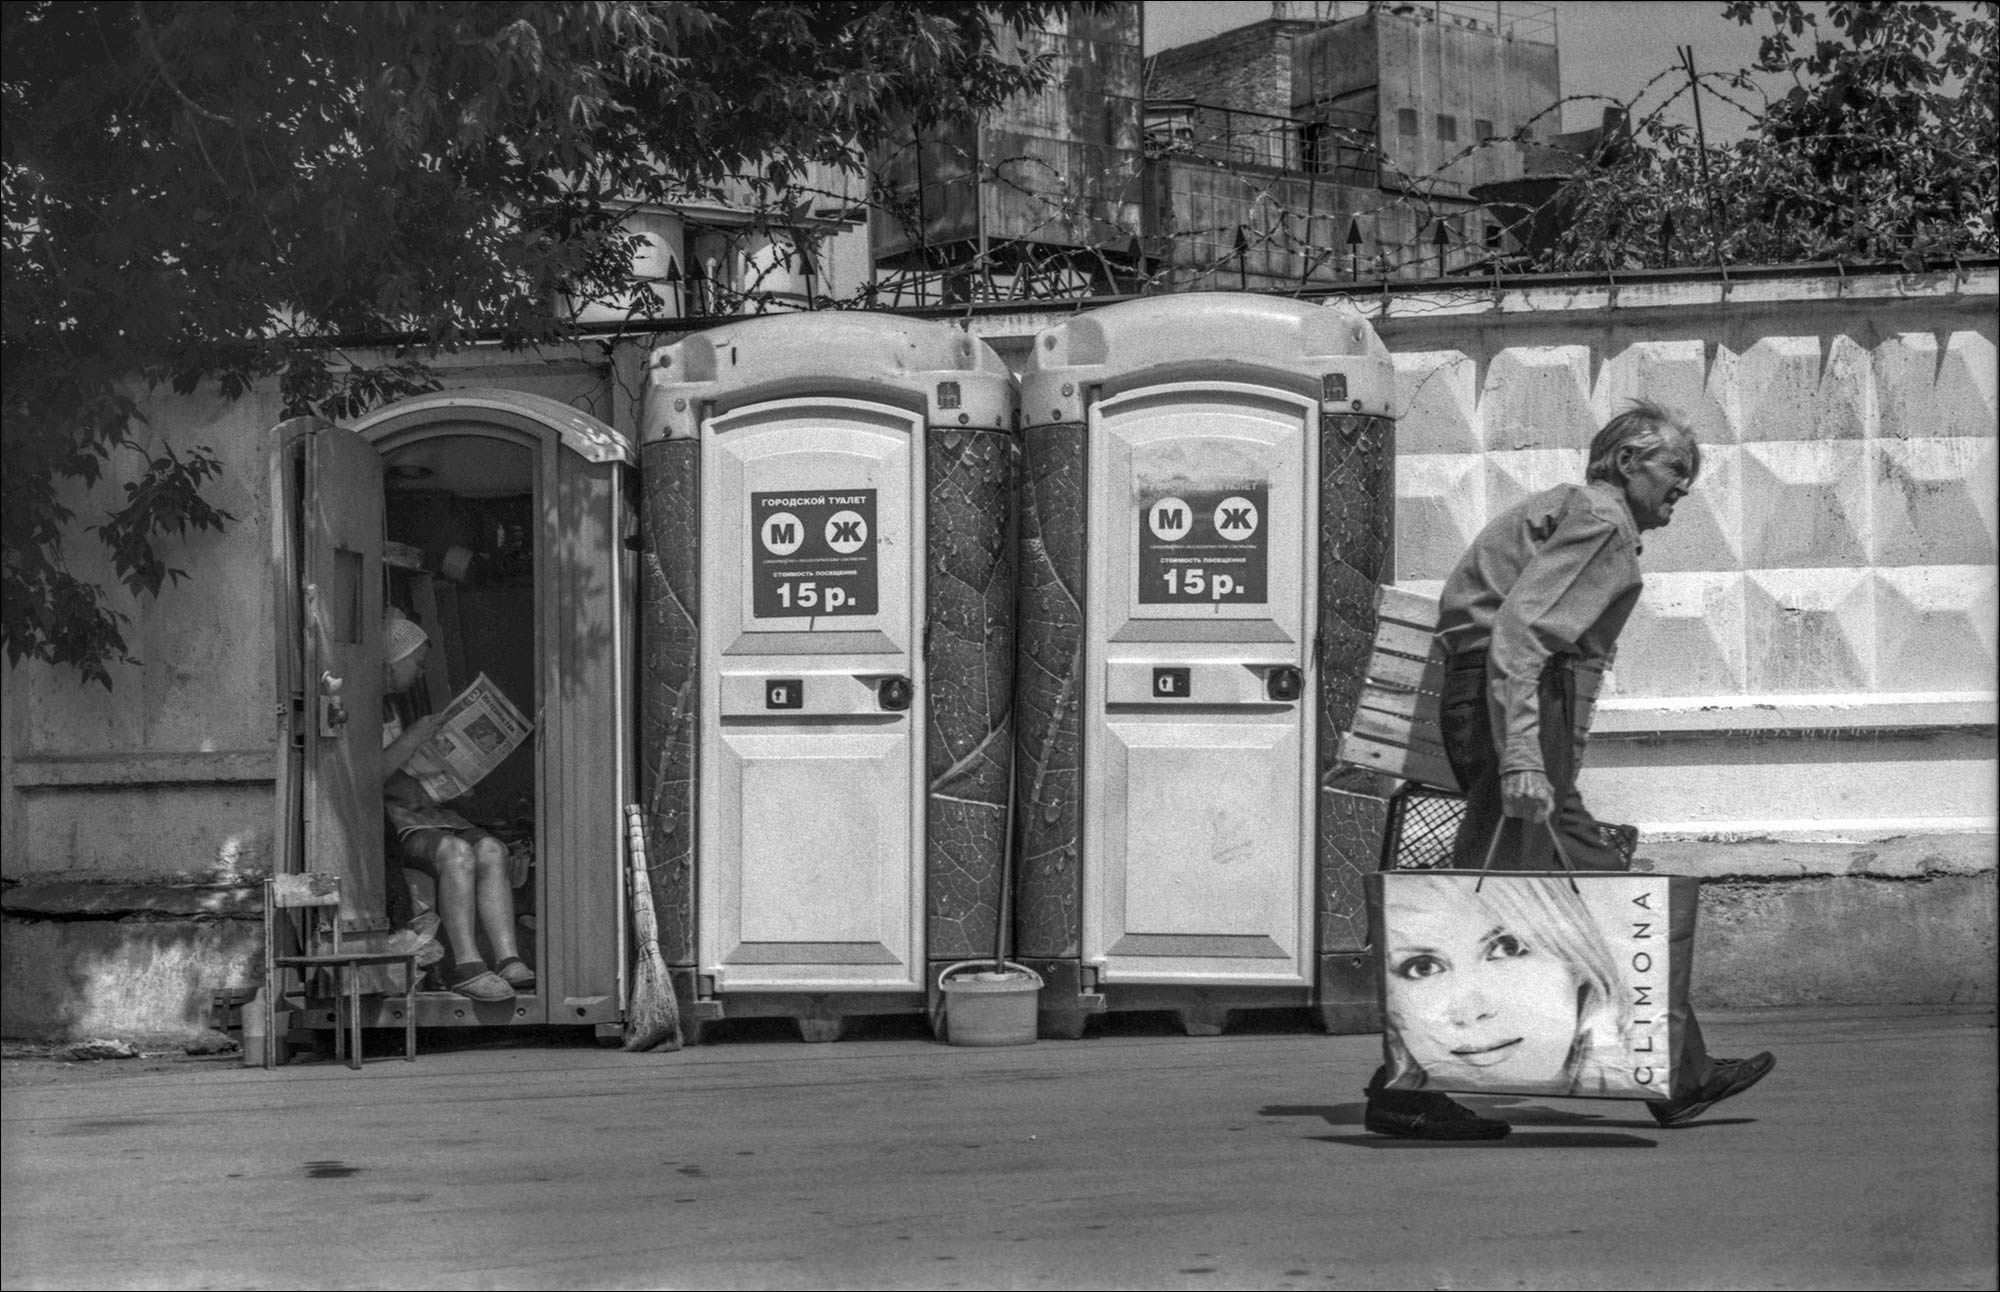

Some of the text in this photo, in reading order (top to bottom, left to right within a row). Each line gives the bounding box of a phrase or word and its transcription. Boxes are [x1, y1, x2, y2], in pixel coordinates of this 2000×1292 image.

[761, 495, 867, 507] ГОРОДСКОЙ ТУАЛЕТ
[1158, 508, 1252, 530] М Ж
[770, 521, 863, 545] М Ж
[1163, 568, 1206, 595] 15
[776, 582, 818, 608] 15
[1632, 892, 1653, 1085] CLIMONA
